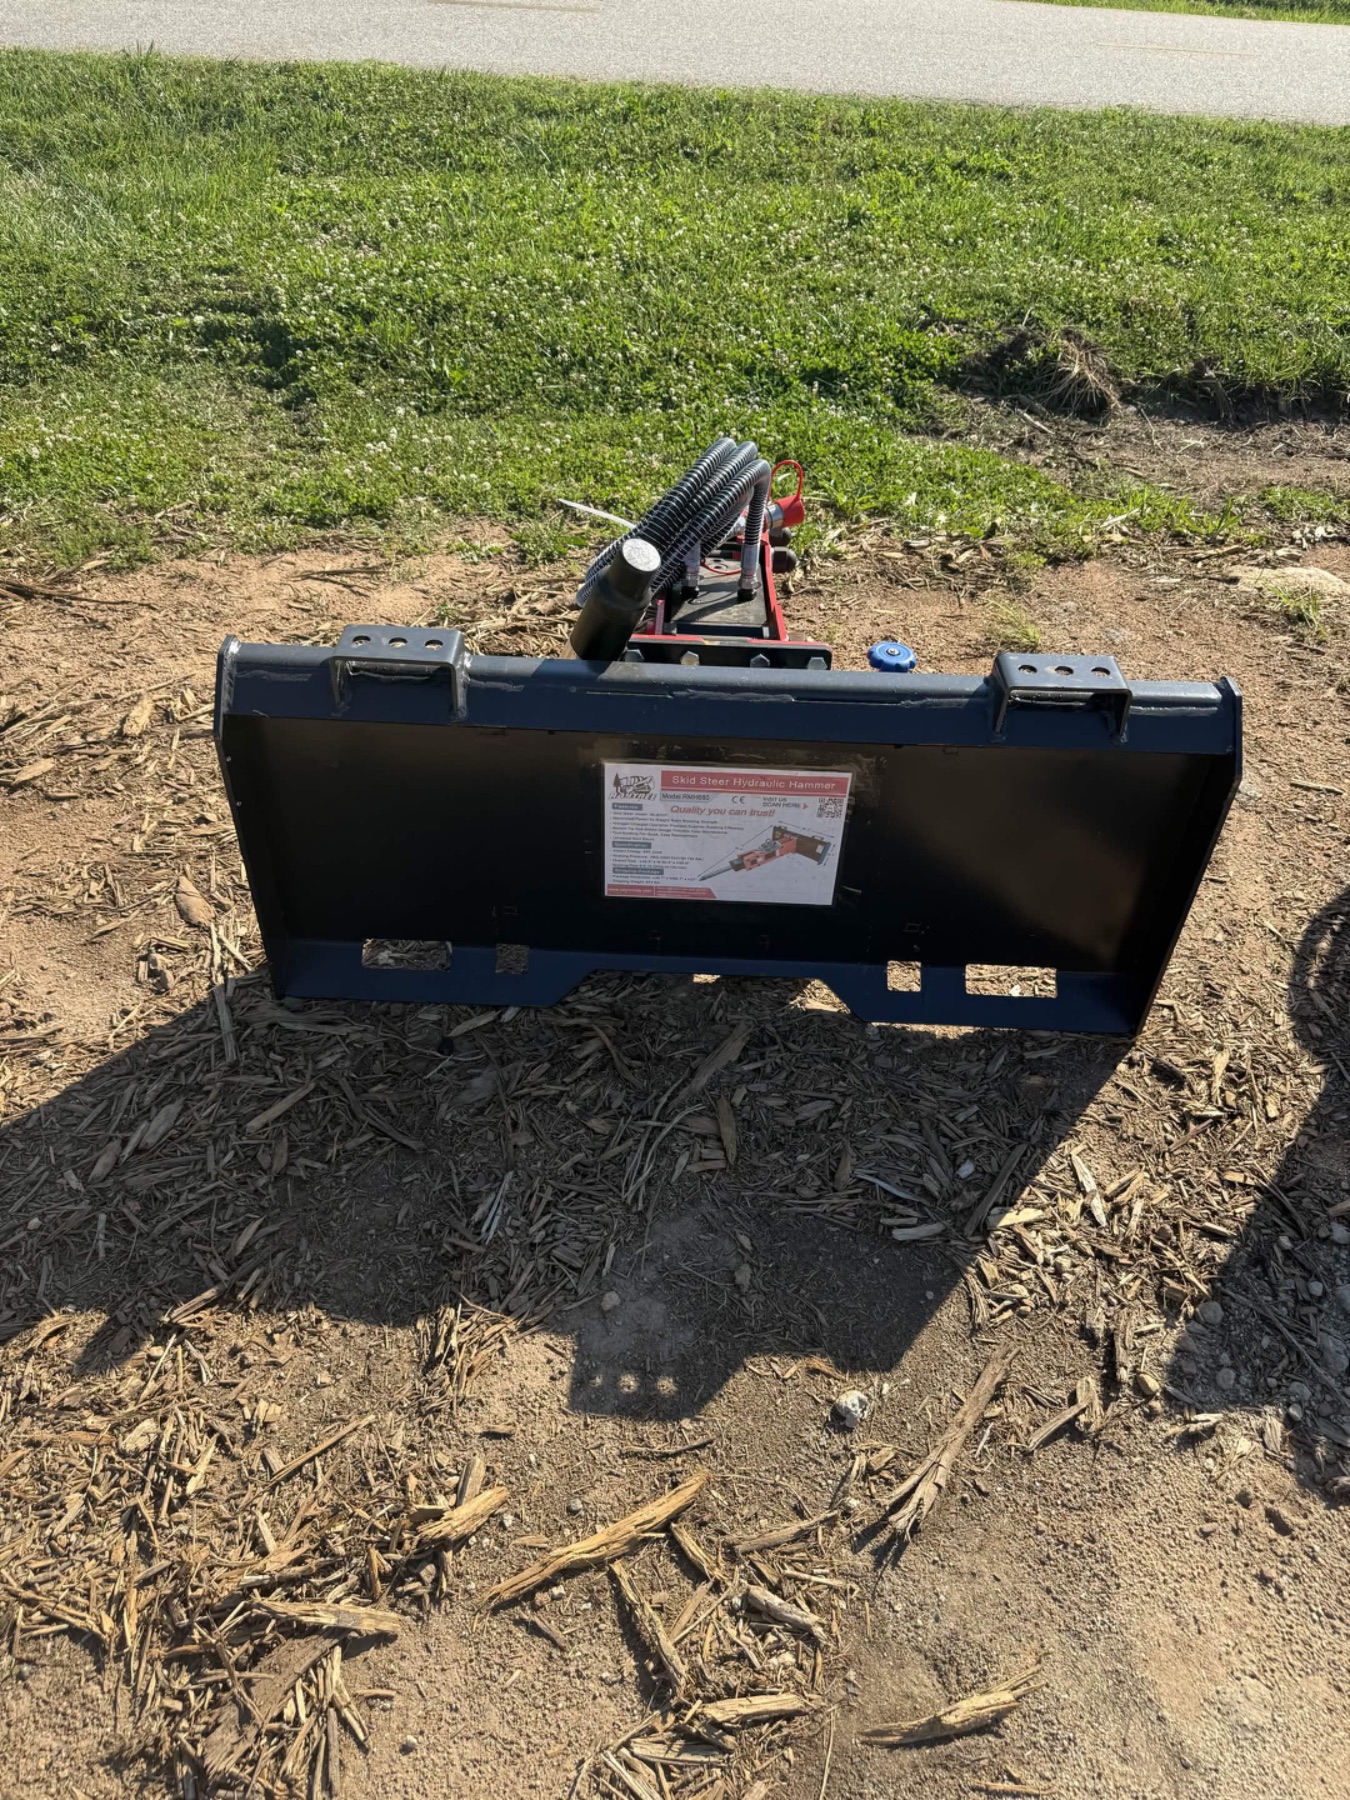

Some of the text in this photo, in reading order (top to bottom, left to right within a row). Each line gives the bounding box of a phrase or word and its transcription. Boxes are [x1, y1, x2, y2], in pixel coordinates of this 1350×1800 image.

[672, 776, 836, 790] Skid Steer Hydraulic Hammer
[670, 805, 705, 815] Quality
[707, 808, 726, 816] you
[729, 808, 747, 816] can
[749, 808, 776, 817] trust!
